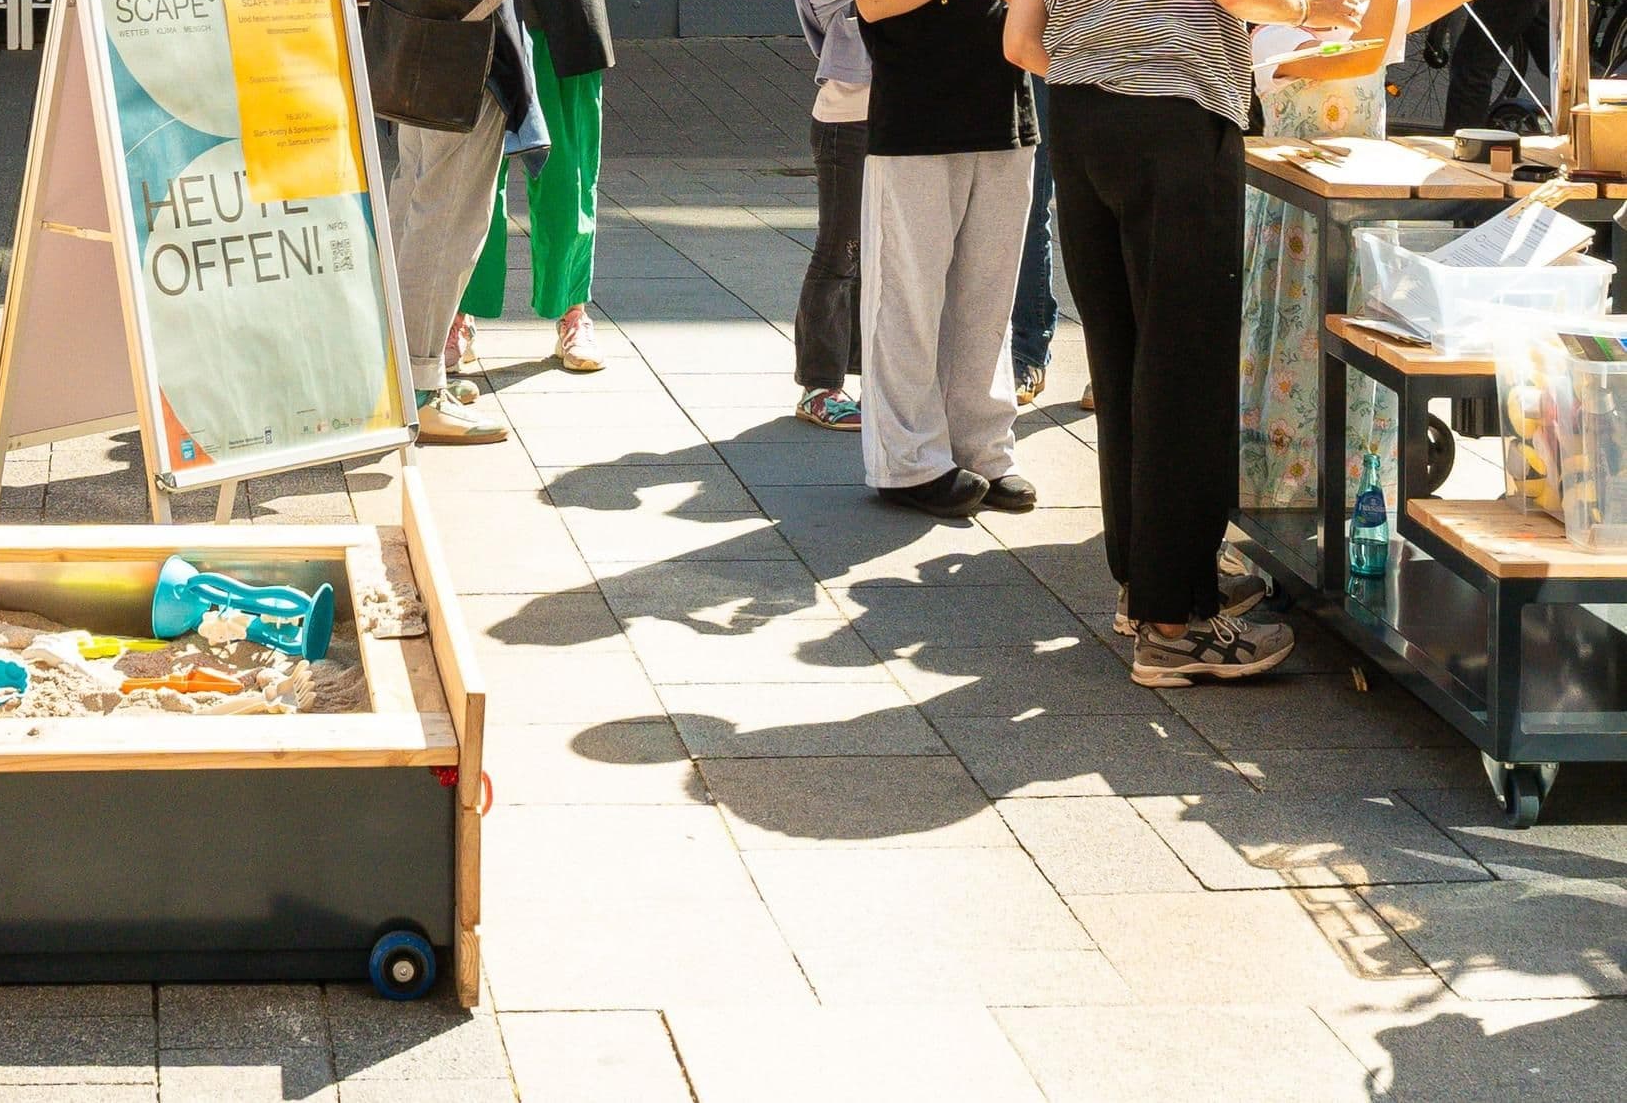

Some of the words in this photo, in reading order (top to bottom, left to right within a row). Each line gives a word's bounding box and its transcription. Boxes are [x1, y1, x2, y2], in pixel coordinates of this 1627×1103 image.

[119, 28, 149, 38] WETTER
[156, 26, 177, 35] KLIMA
[142, 170, 308, 232] HEU
[152, 225, 324, 296] OFFEN!
